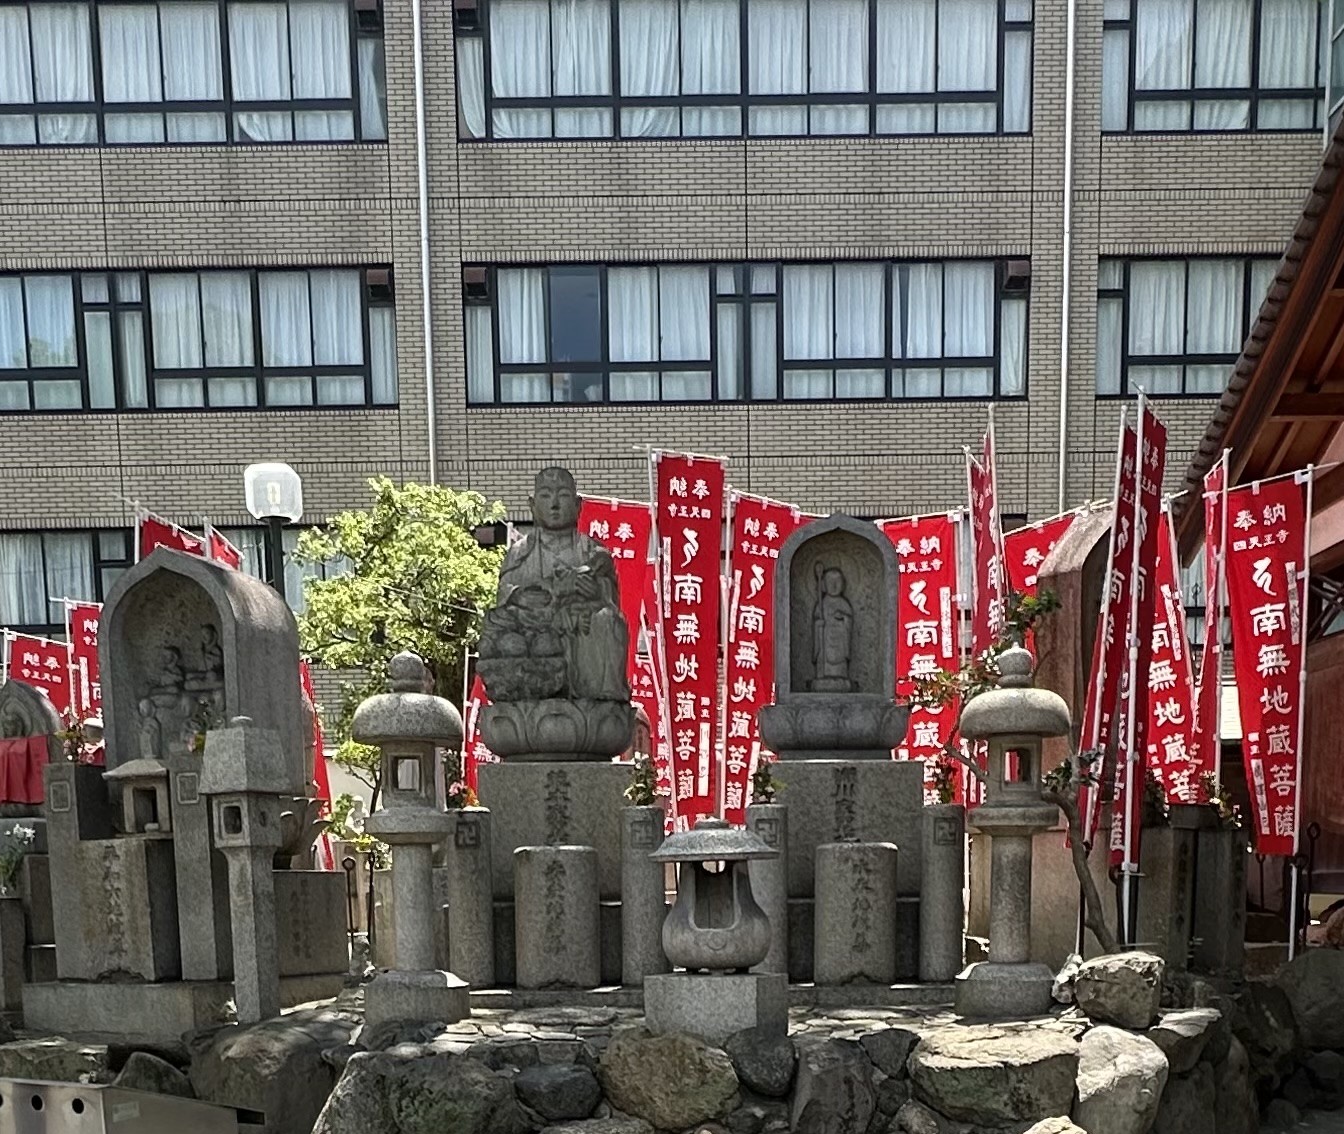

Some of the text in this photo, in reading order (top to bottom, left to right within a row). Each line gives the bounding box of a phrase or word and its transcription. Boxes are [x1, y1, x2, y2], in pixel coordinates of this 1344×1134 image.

[1233, 503, 1287, 531] 奉納
[896, 535, 941, 557] 奉納
[1233, 529, 1290, 551] 四天王寺
[1250, 602, 1296, 837] 南無地蔵菩薩
